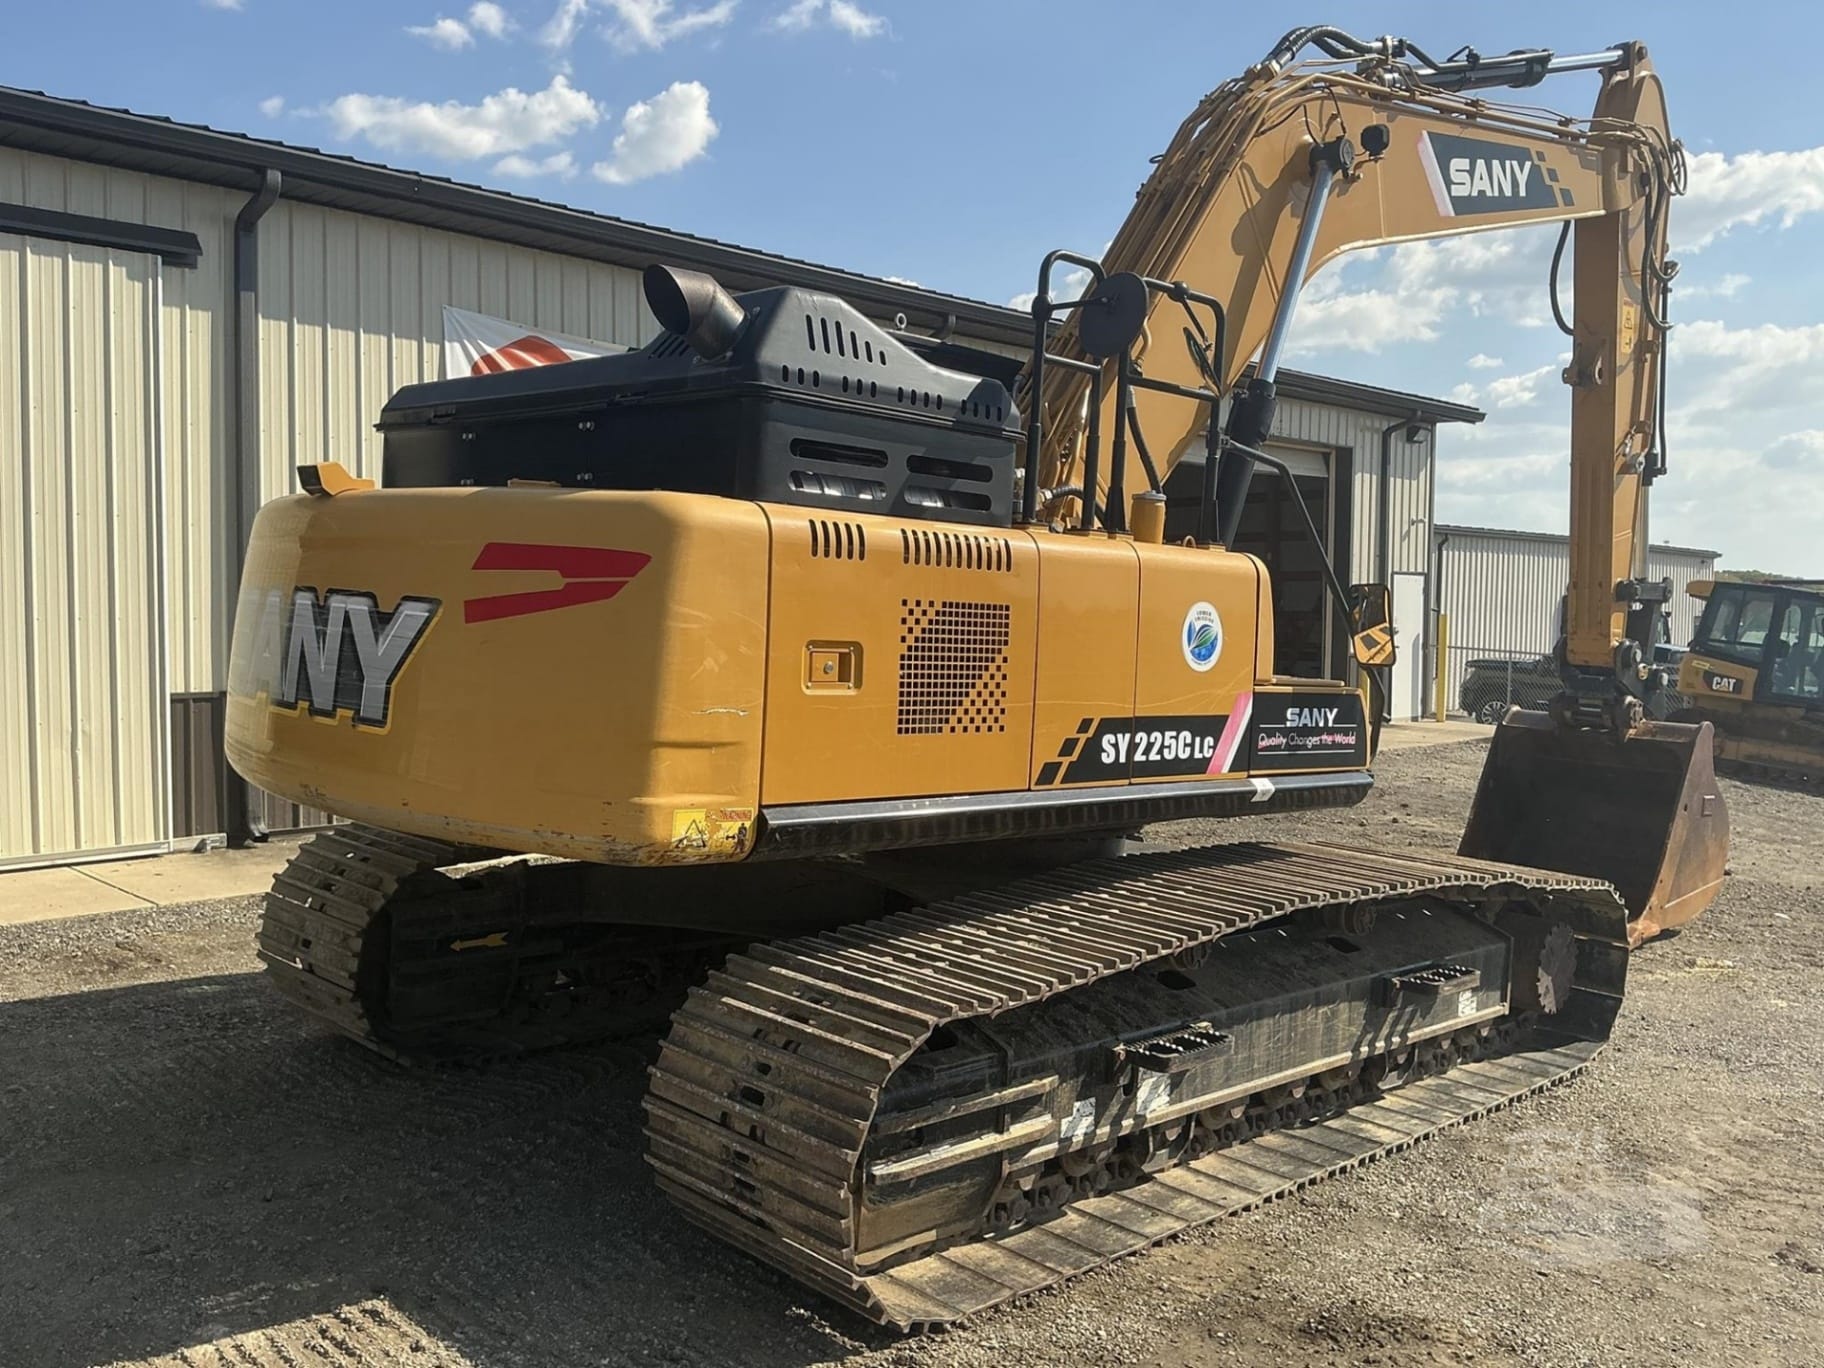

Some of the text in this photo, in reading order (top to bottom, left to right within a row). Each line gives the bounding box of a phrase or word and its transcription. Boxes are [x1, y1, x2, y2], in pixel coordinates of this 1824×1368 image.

[1449, 158, 1532, 197] SANY
[238, 588, 434, 722] ANY
[1712, 676, 1736, 692] CAT
[1286, 708, 1338, 727] SANY
[1258, 731, 1356, 749] Quality Changes the World
